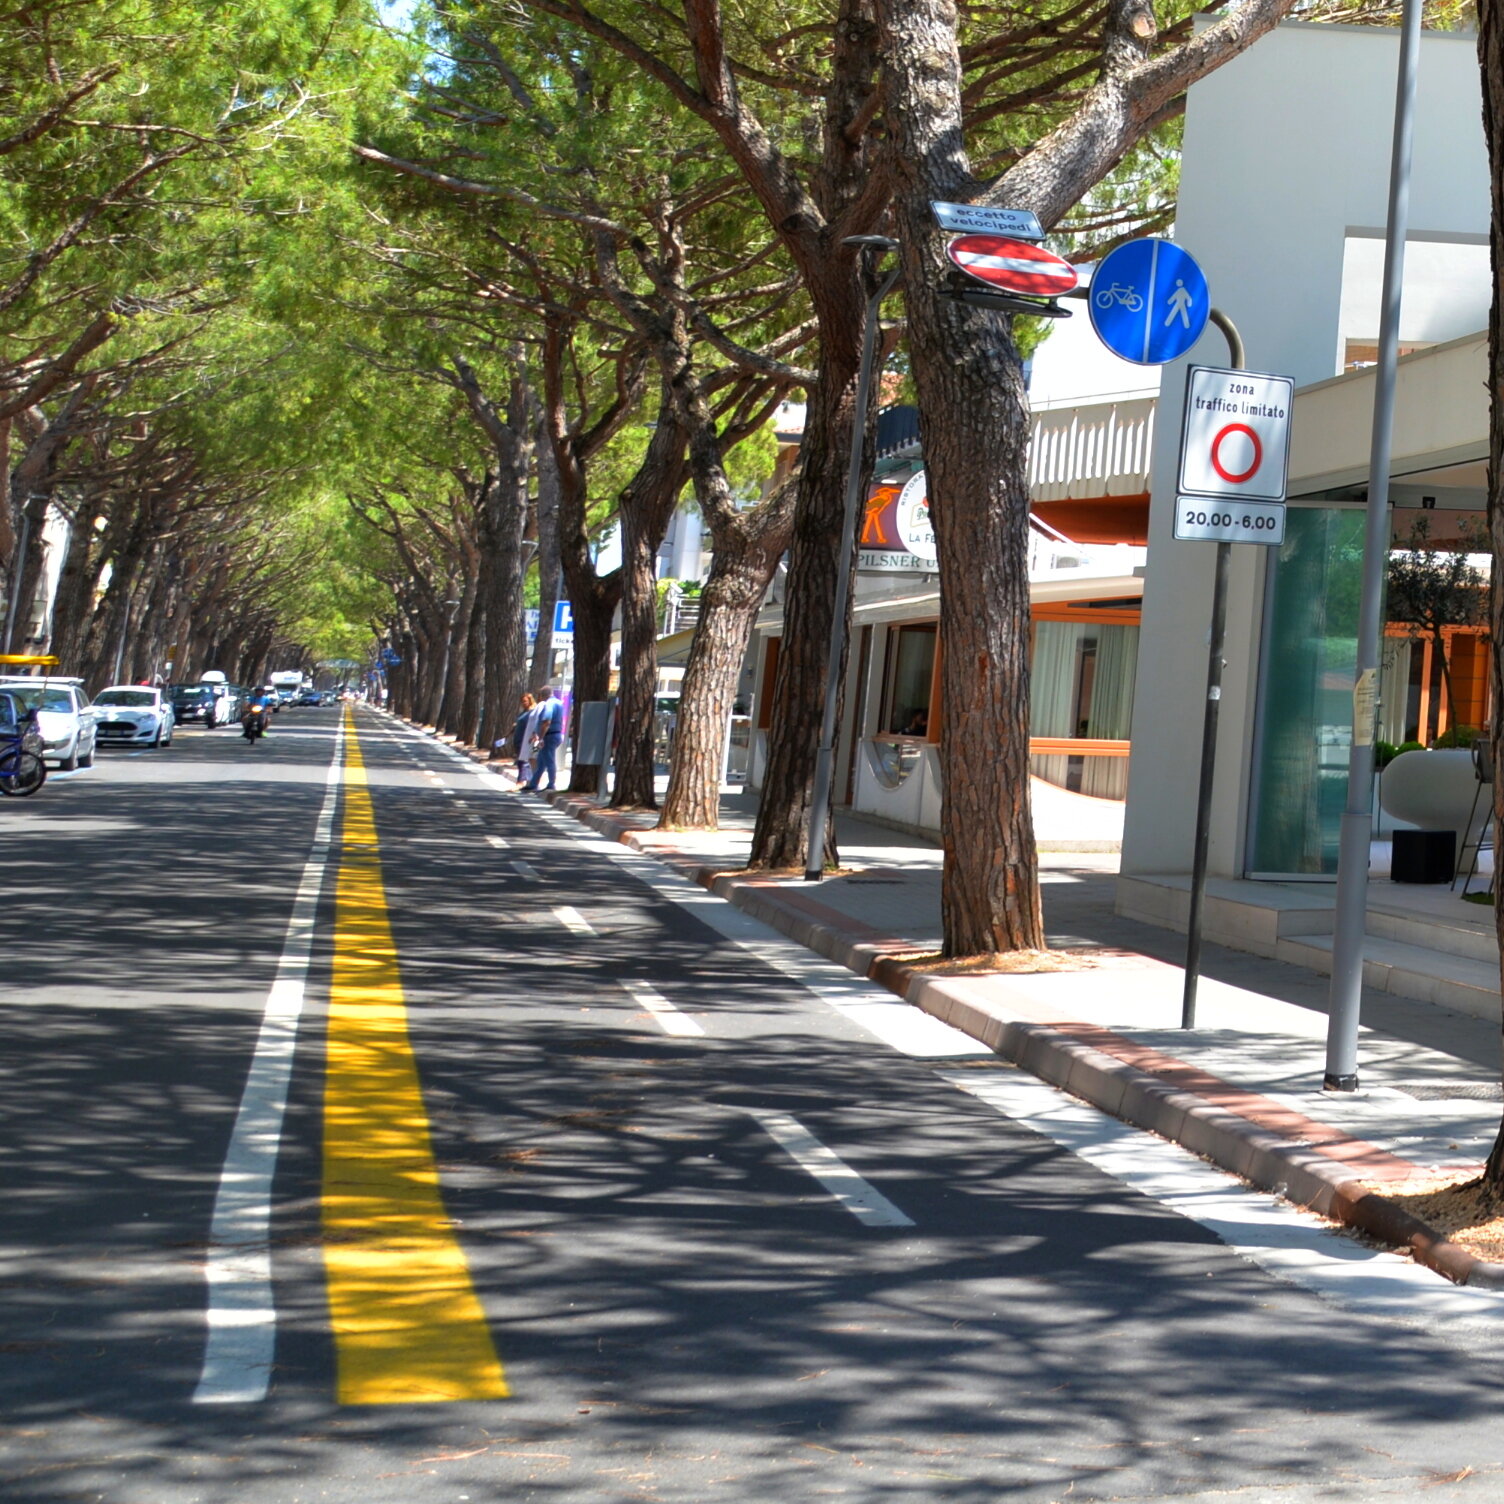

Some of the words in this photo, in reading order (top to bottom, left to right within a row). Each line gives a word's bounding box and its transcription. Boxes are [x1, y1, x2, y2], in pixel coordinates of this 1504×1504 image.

[957, 209, 1016, 221] eccetto
[950, 217, 1031, 232] velocipedi
[1229, 382, 1255, 396] zona
[1195, 395, 1238, 413] traffico
[1241, 400, 1285, 419] limitato
[909, 533, 921, 543] LA
